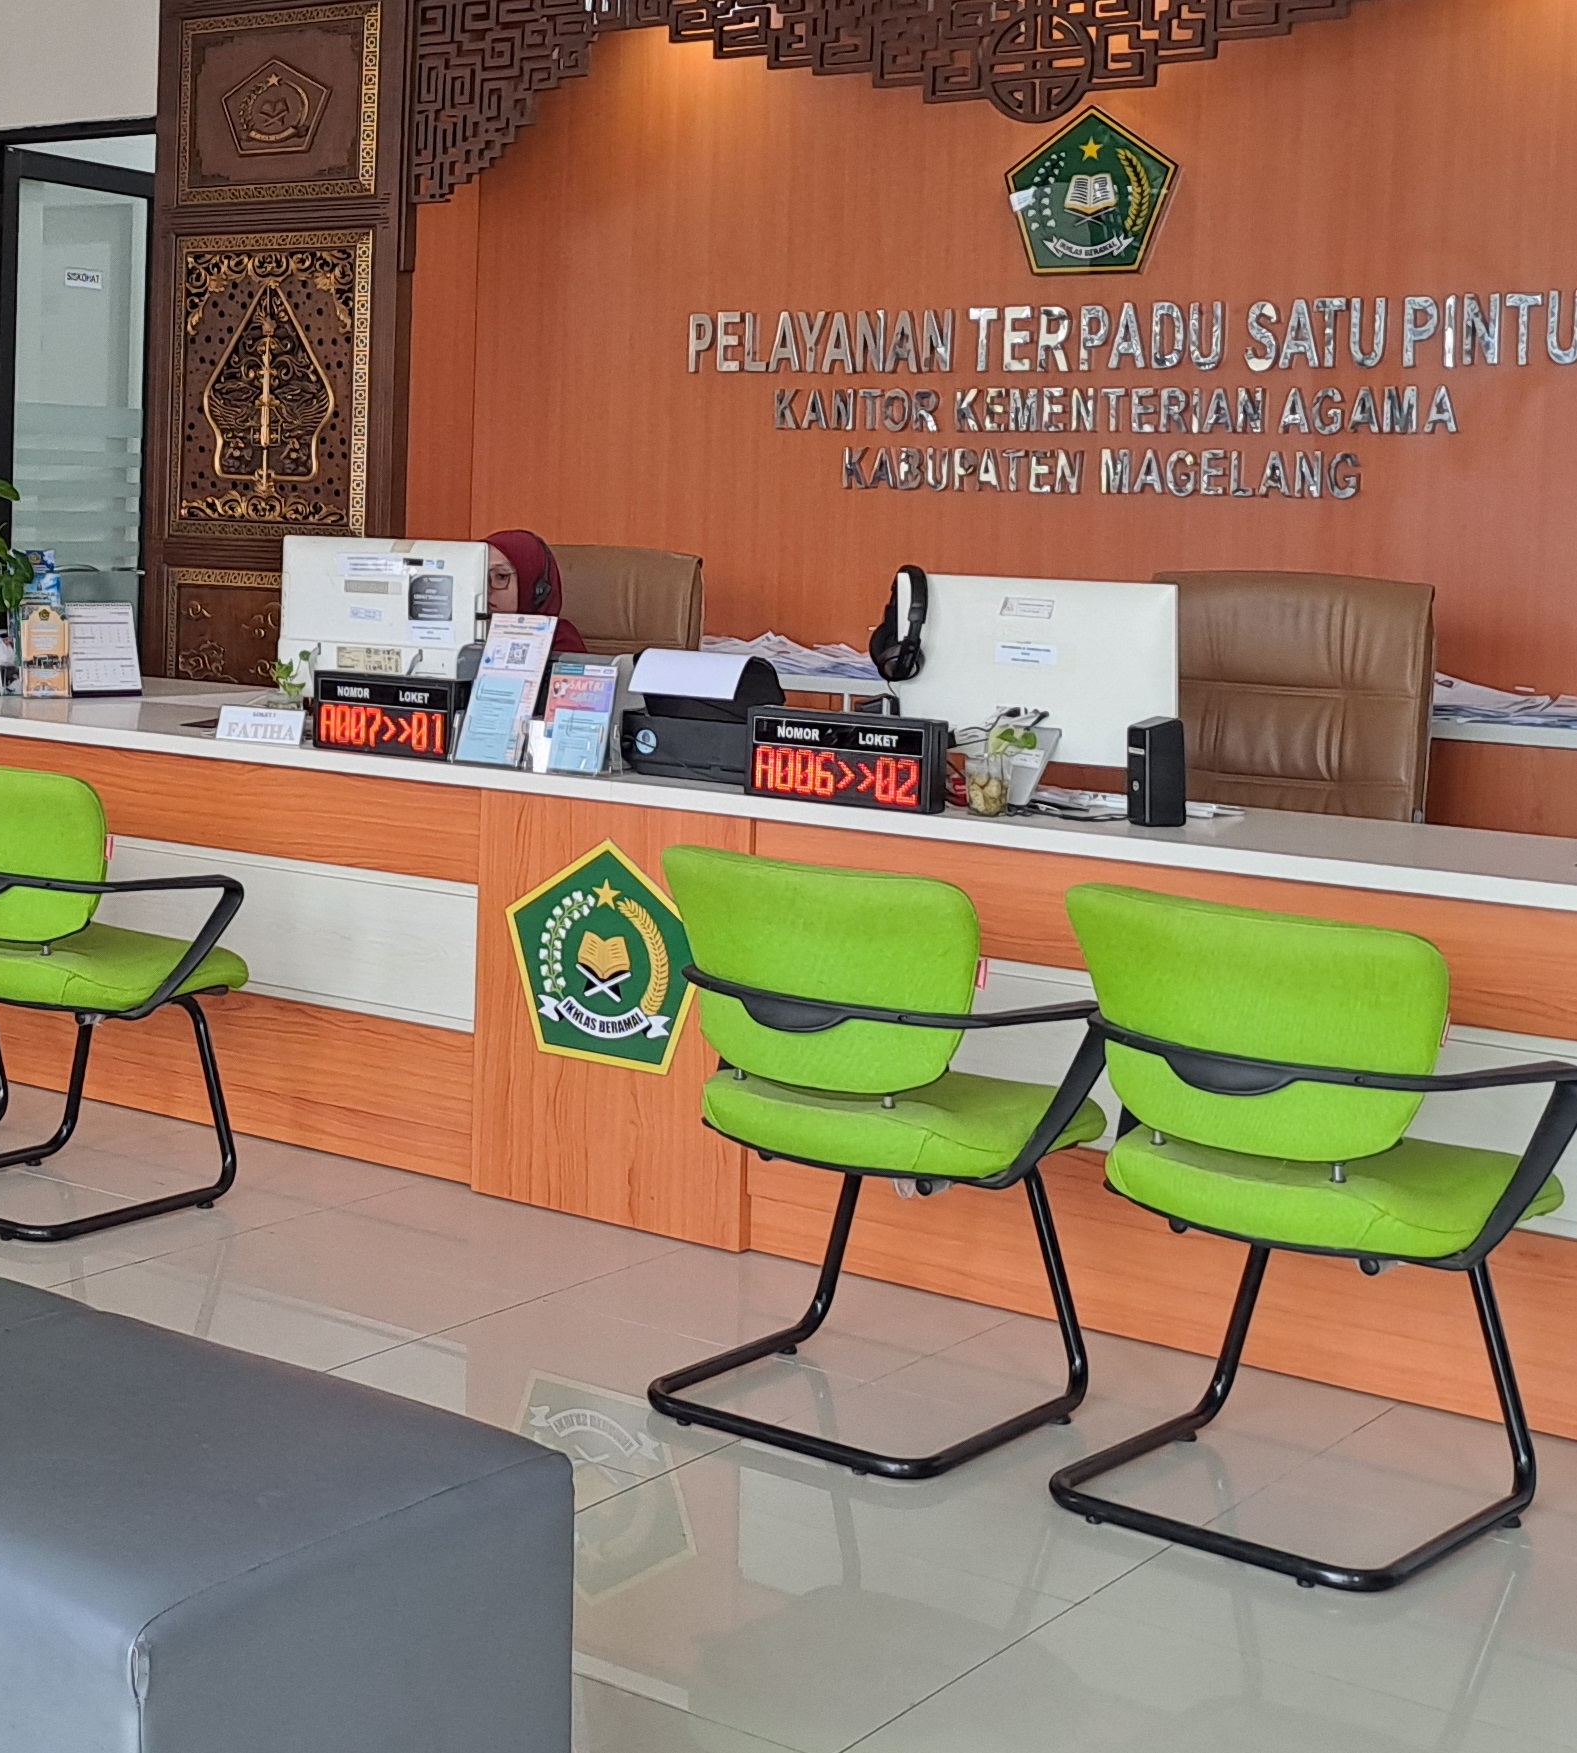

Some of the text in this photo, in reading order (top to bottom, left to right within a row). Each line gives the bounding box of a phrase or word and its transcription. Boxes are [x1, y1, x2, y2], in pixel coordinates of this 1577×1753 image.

[688, 290, 1577, 374] PELAYANAN TERPADU SATU PINTU
[774, 385, 1459, 434] KANTOR KEMENTERIAN AGAMA
[842, 447, 1362, 499] KABUPATEN MAGELANG
[336, 685, 430, 704] NOMOR LOKET
[227, 721, 295, 741] FATIHA
[776, 725, 900, 748] NOMOR LOKET
[563, 999, 644, 1034] IKHLAS BERAMAL
